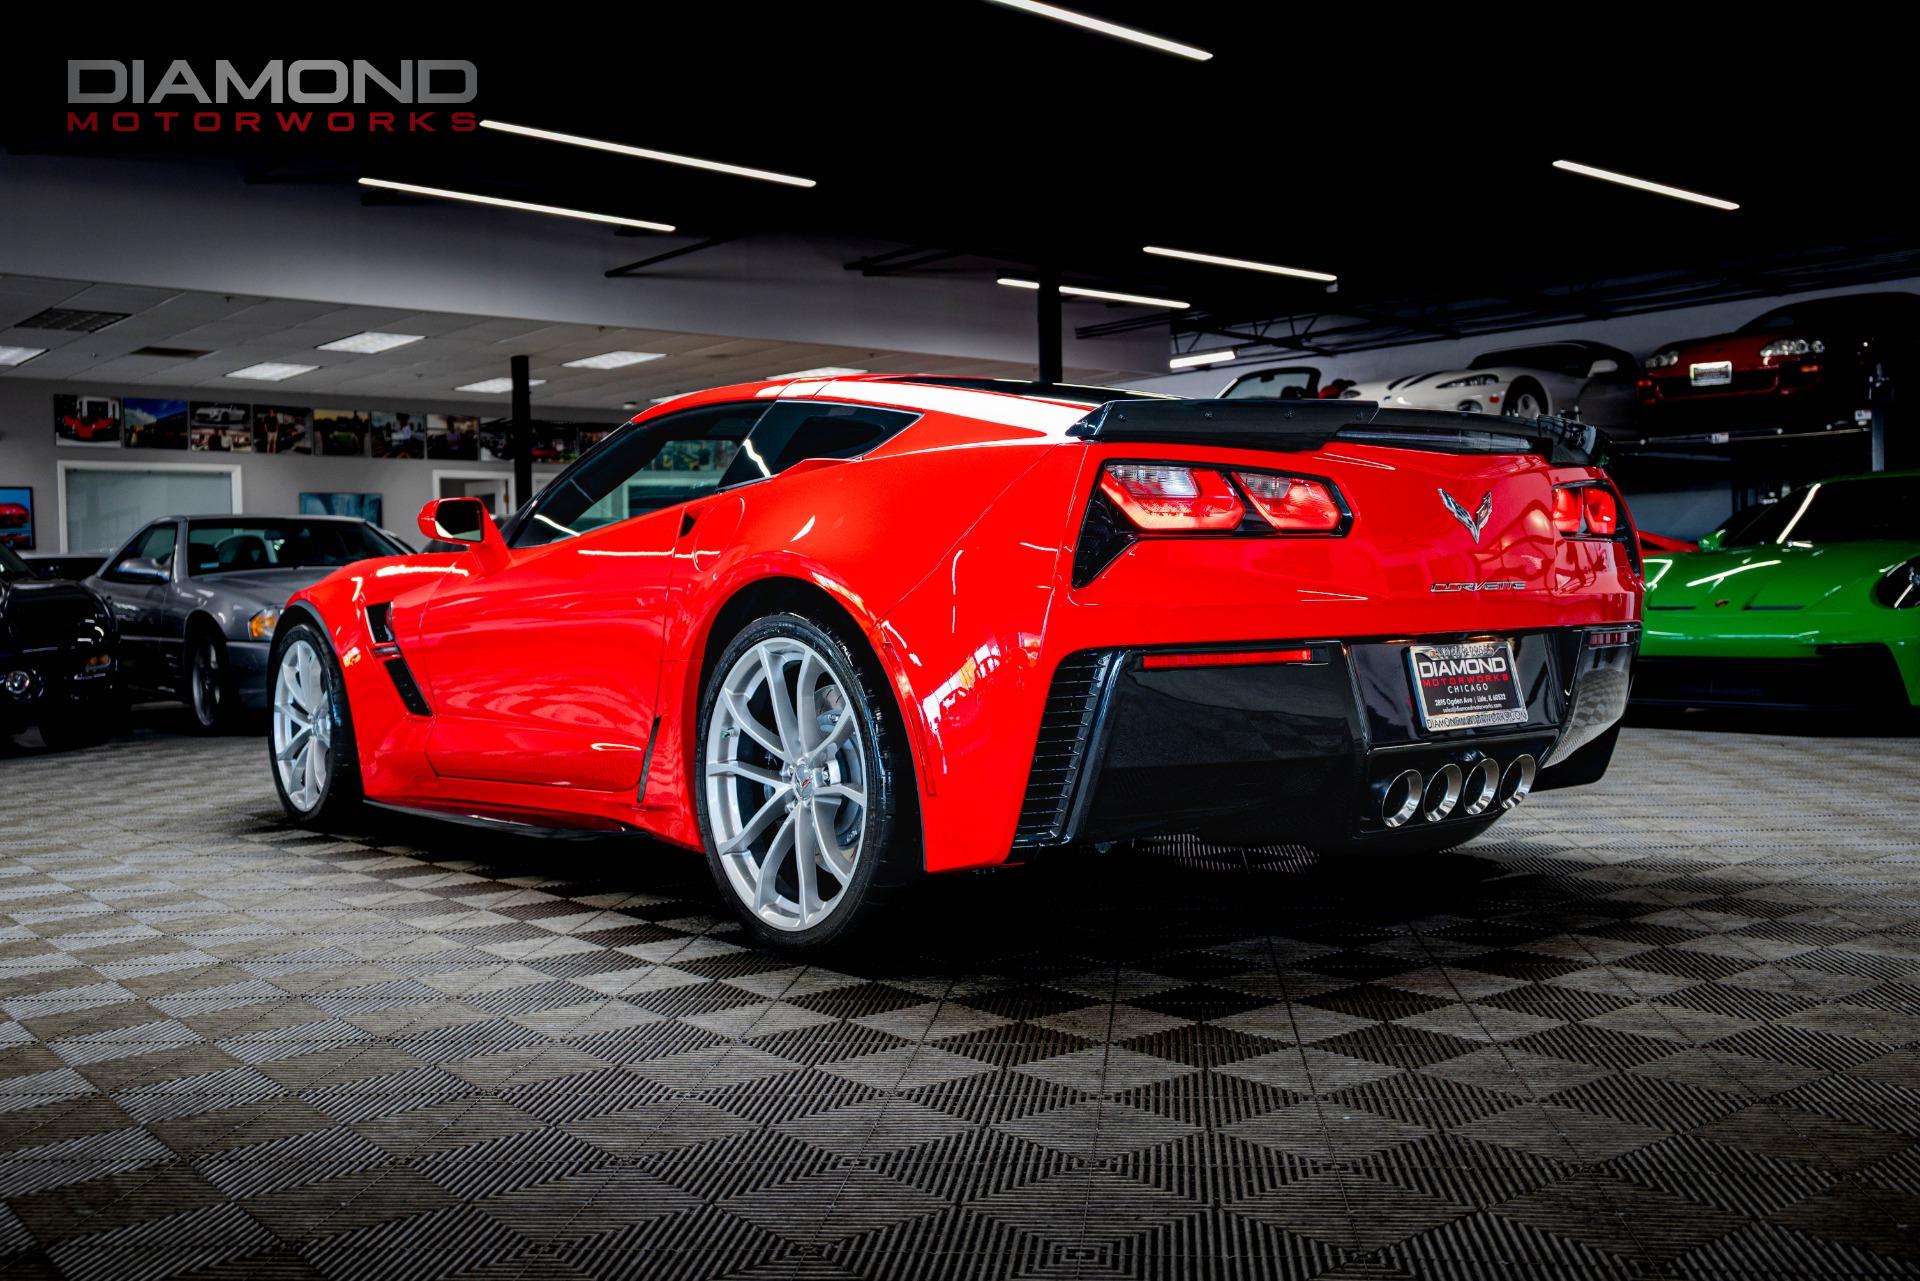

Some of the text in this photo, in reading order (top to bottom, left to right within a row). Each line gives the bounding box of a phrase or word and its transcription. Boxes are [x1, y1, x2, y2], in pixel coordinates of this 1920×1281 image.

[1430, 580, 1527, 592] CORVETTE
[1418, 657, 1507, 678] DIAMOND
[1422, 673, 1510, 688] MOTORWORKS
[1447, 683, 1489, 694] CHICAGO
[1446, 698, 1463, 706] Ogden
